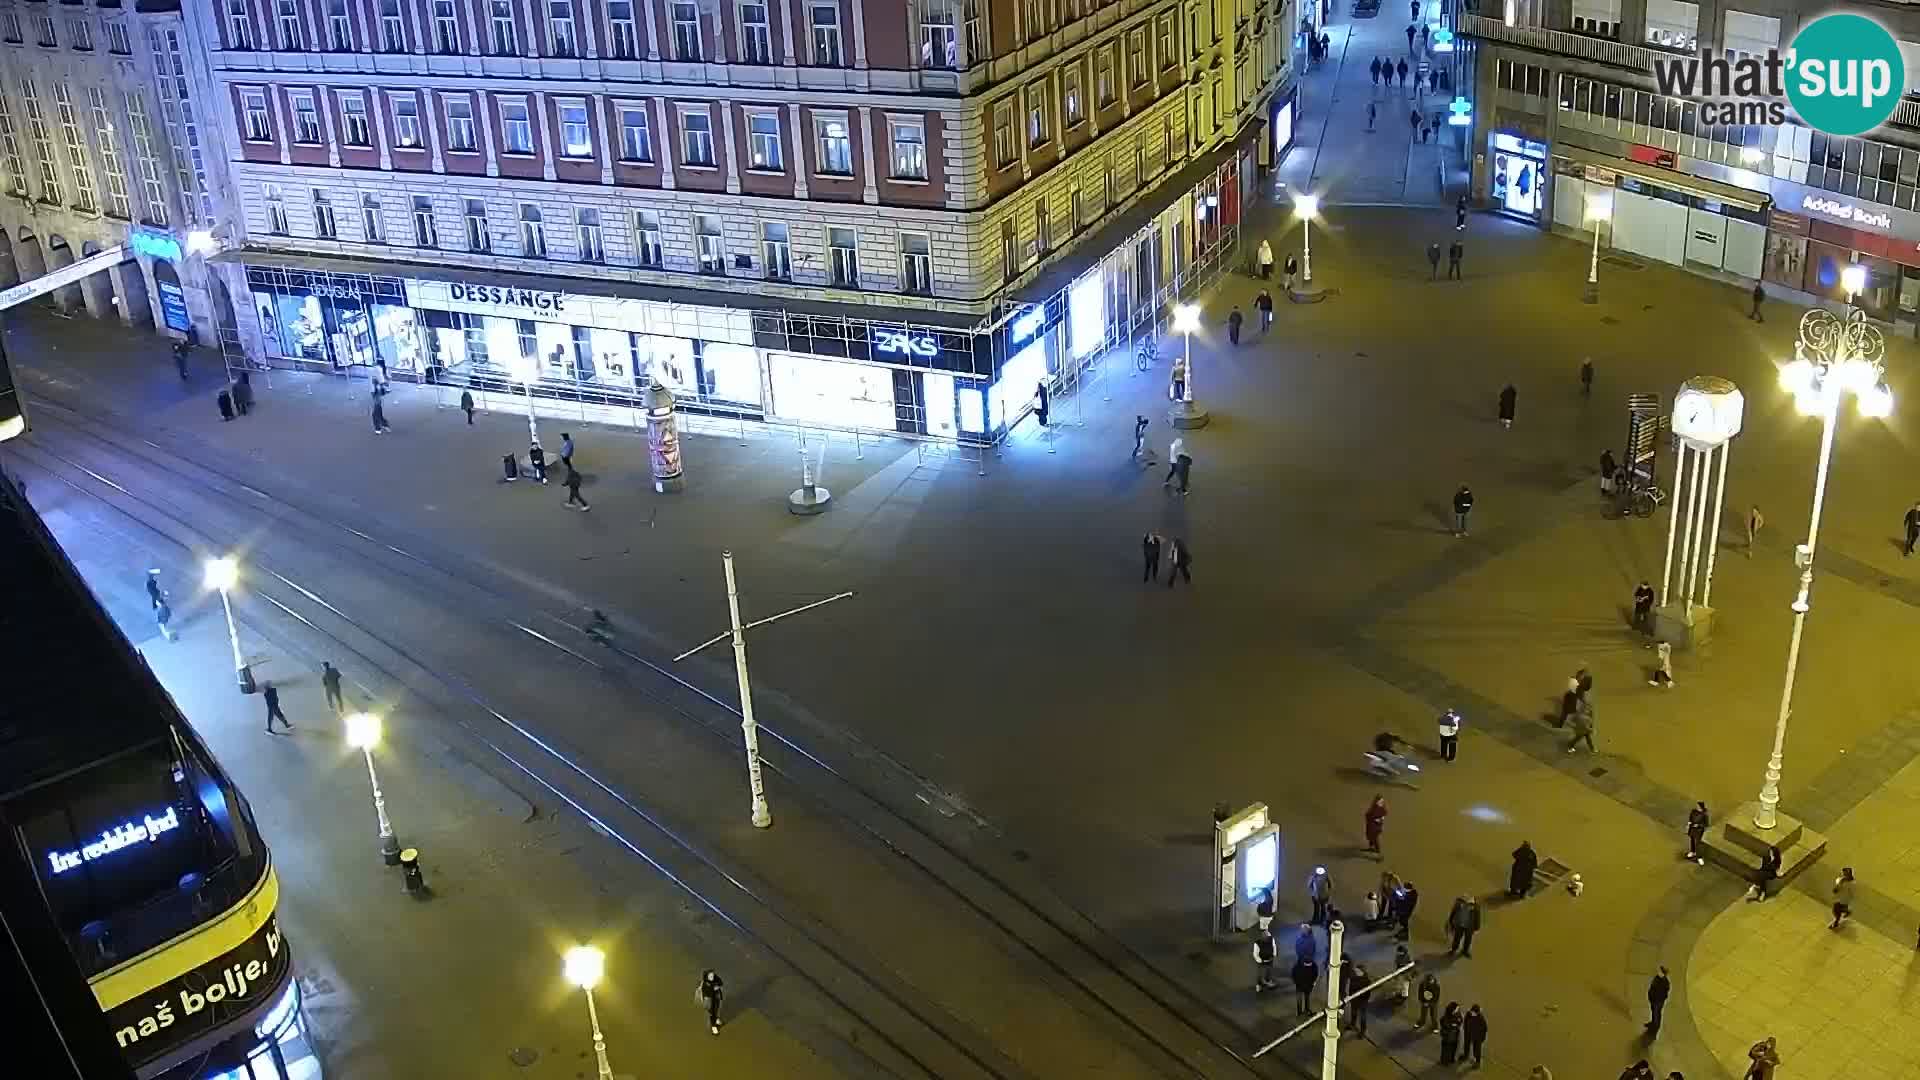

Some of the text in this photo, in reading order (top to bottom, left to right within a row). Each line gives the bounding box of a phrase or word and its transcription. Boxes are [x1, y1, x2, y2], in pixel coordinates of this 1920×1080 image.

[1854, 208, 1891, 229] Bank
[450, 283, 564, 311] DESSANGE
[875, 331, 938, 357] ZAKS
[115, 1000, 176, 1048] naš
[179, 958, 268, 1016] bolje,
